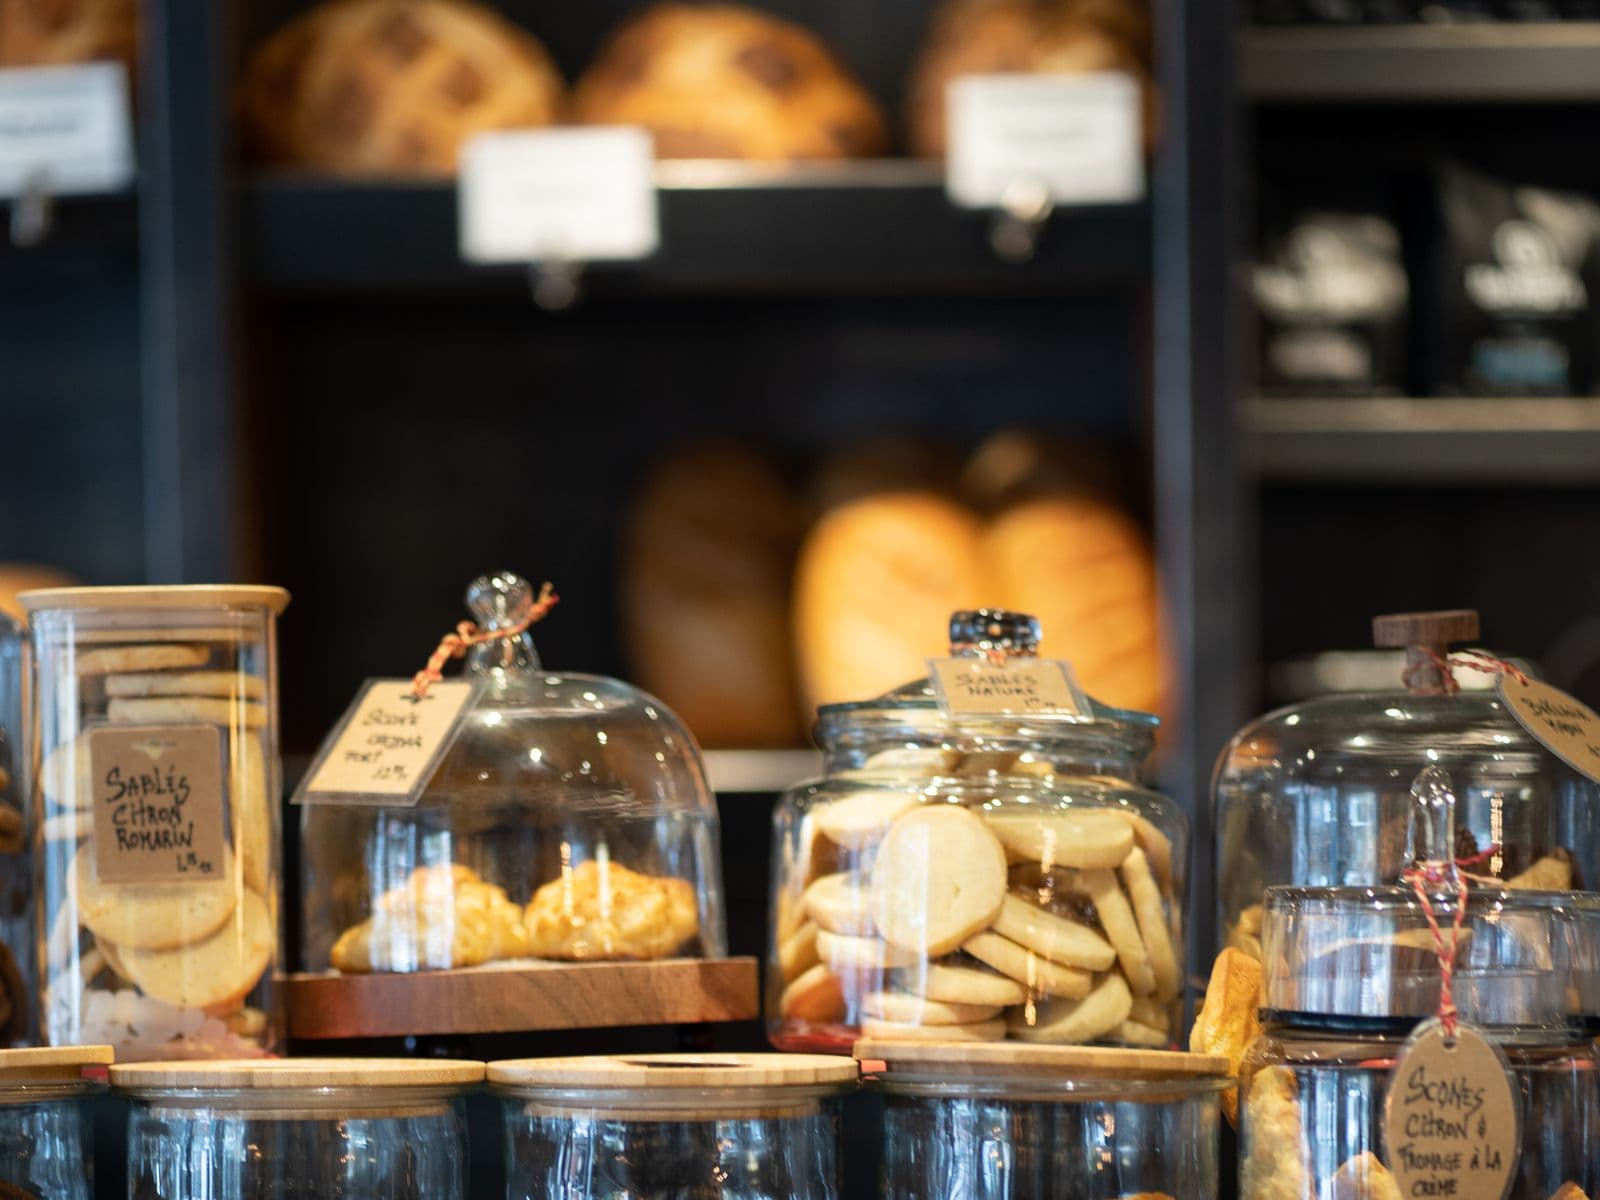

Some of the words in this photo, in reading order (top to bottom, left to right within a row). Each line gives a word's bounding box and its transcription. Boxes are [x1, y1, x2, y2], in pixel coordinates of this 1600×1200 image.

[105, 763, 191, 805] SABLÉS
[115, 821, 194, 851] ROMARIN
[1404, 1065, 1486, 1118] SCONES
[1404, 1110, 1468, 1140] CITRON
[1485, 1143, 1502, 1171] LA
[1411, 1172, 1457, 1197] CRÈME
